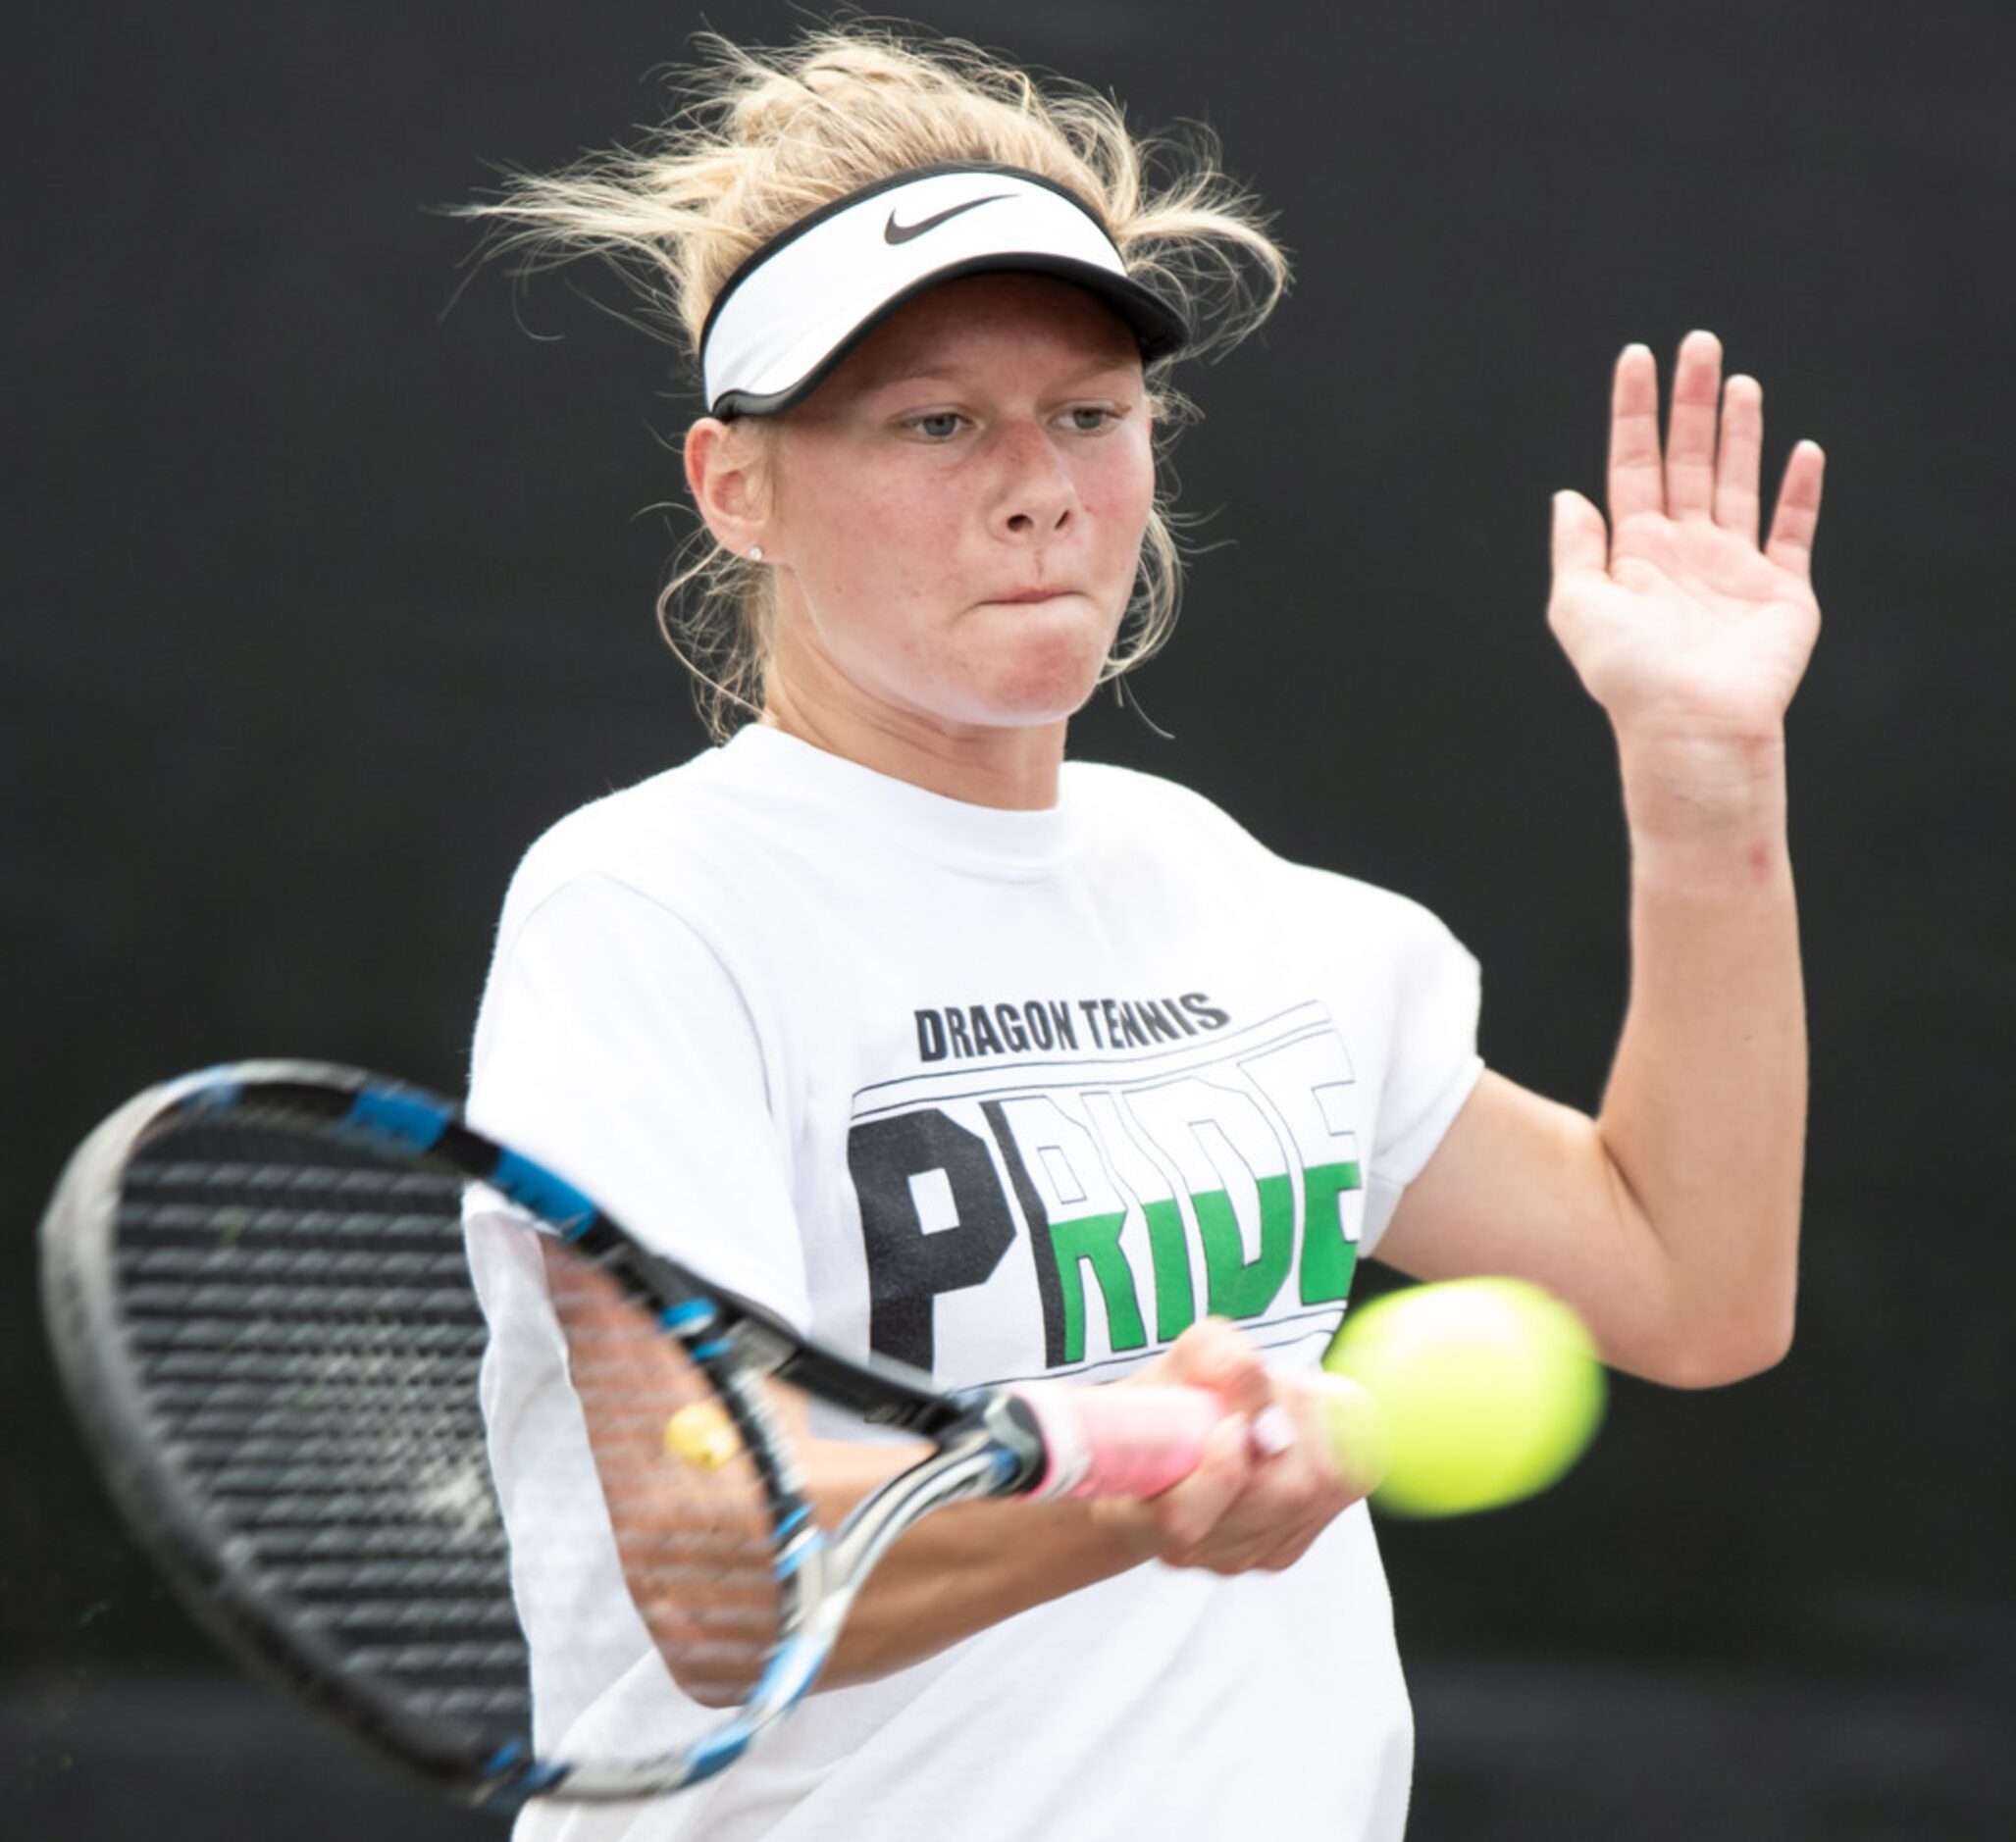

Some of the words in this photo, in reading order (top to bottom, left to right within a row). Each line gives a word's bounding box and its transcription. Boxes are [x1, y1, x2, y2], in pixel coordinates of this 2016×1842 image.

[913, 1000, 1079, 1062] DRAGON
[1079, 993, 1230, 1049] TENNIS
[848, 1030, 1362, 1374] PRIDE
